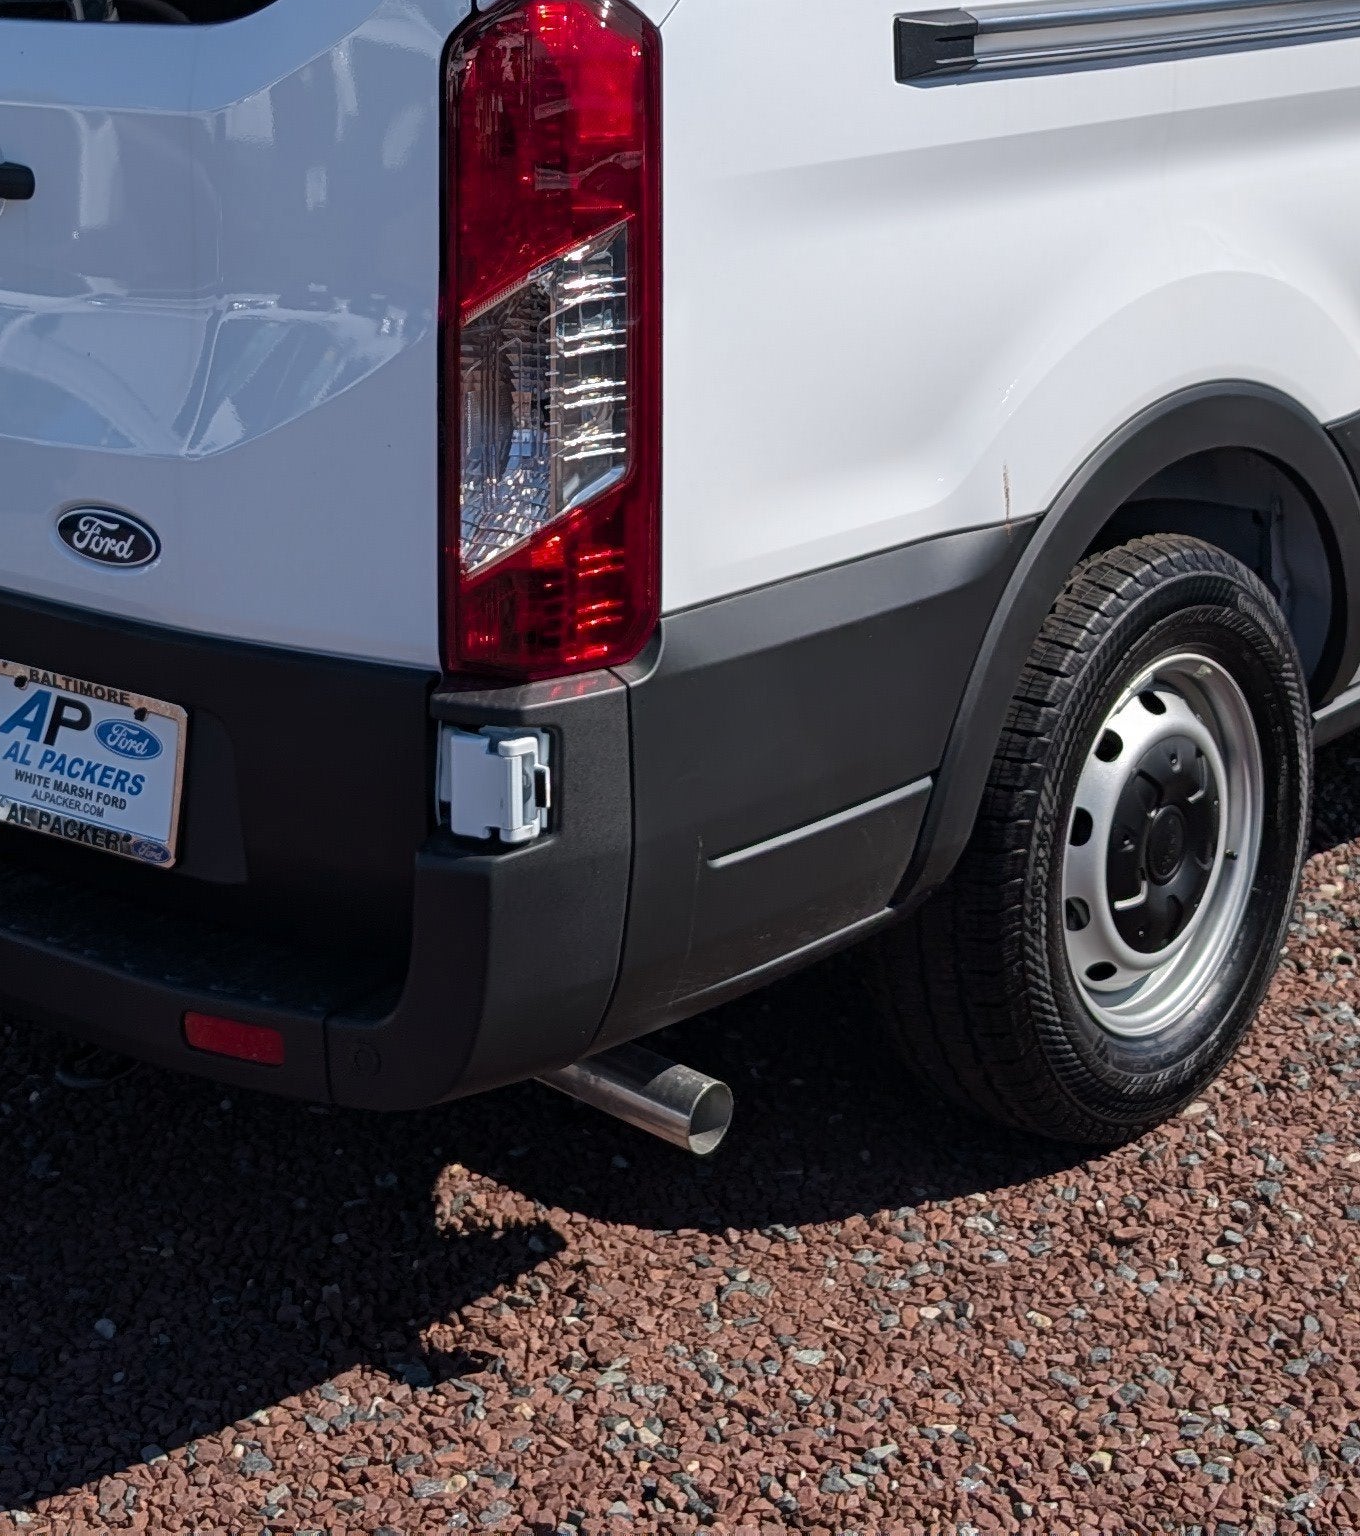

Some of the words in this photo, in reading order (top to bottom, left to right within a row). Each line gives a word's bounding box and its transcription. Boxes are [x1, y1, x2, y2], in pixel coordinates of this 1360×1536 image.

[73, 516, 136, 559] Ford
[29, 668, 131, 708] BALTIMORE
[106, 722, 149, 757] Ford
[2, 741, 32, 766] AL
[38, 749, 146, 796] PACKERS
[14, 769, 50, 788] WHITE
[53, 778, 93, 800] MARSH
[96, 791, 127, 811] FORD
[31, 790, 105, 818] ALPACKER.COM
[6, 802, 32, 826] AL
